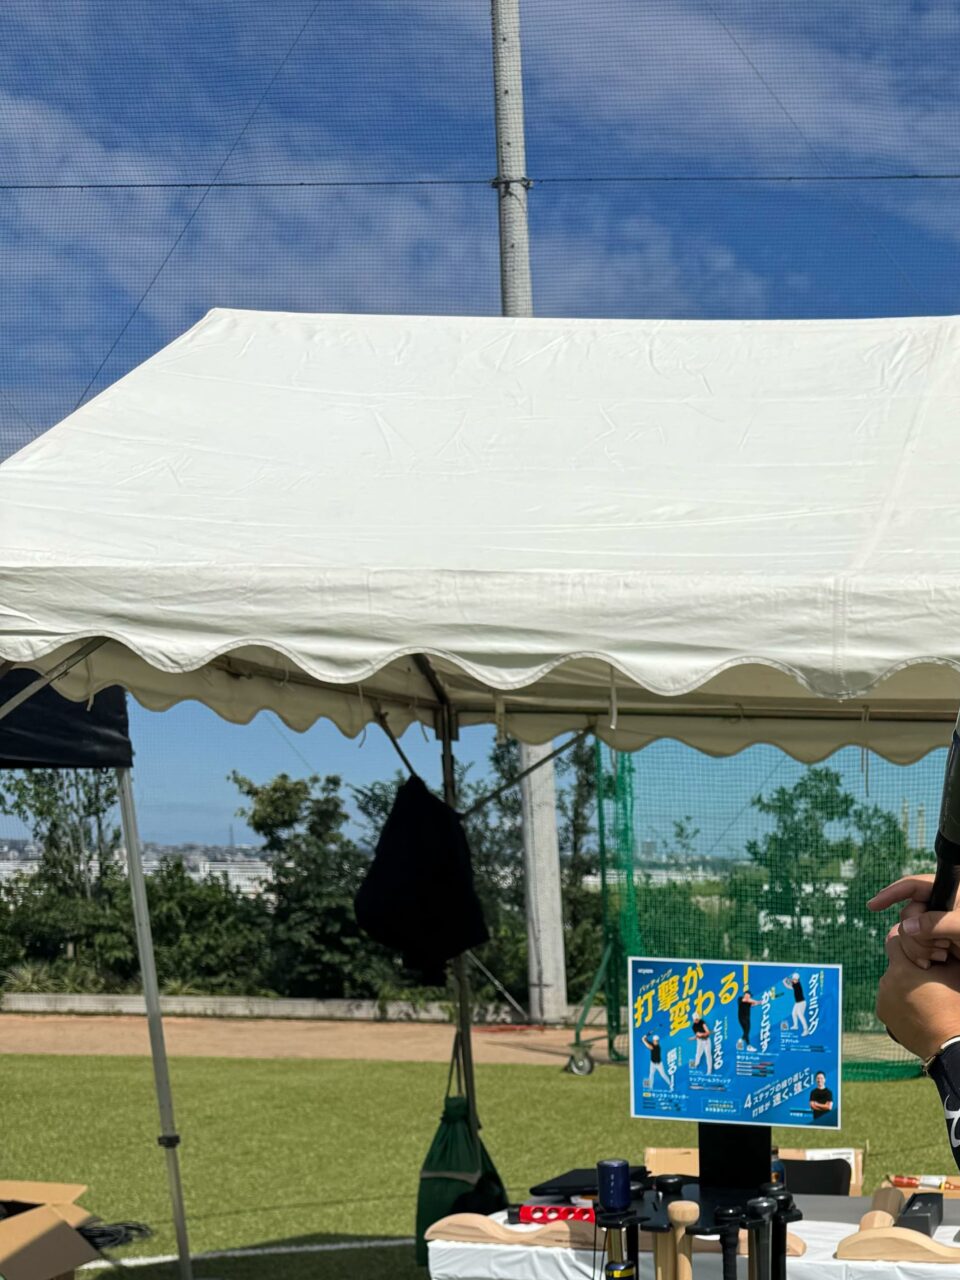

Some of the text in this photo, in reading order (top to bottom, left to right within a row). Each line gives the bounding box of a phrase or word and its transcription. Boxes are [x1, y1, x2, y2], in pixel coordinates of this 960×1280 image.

[634, 963, 704, 1028] 打撃が
[808, 973, 819, 1035] タイミング
